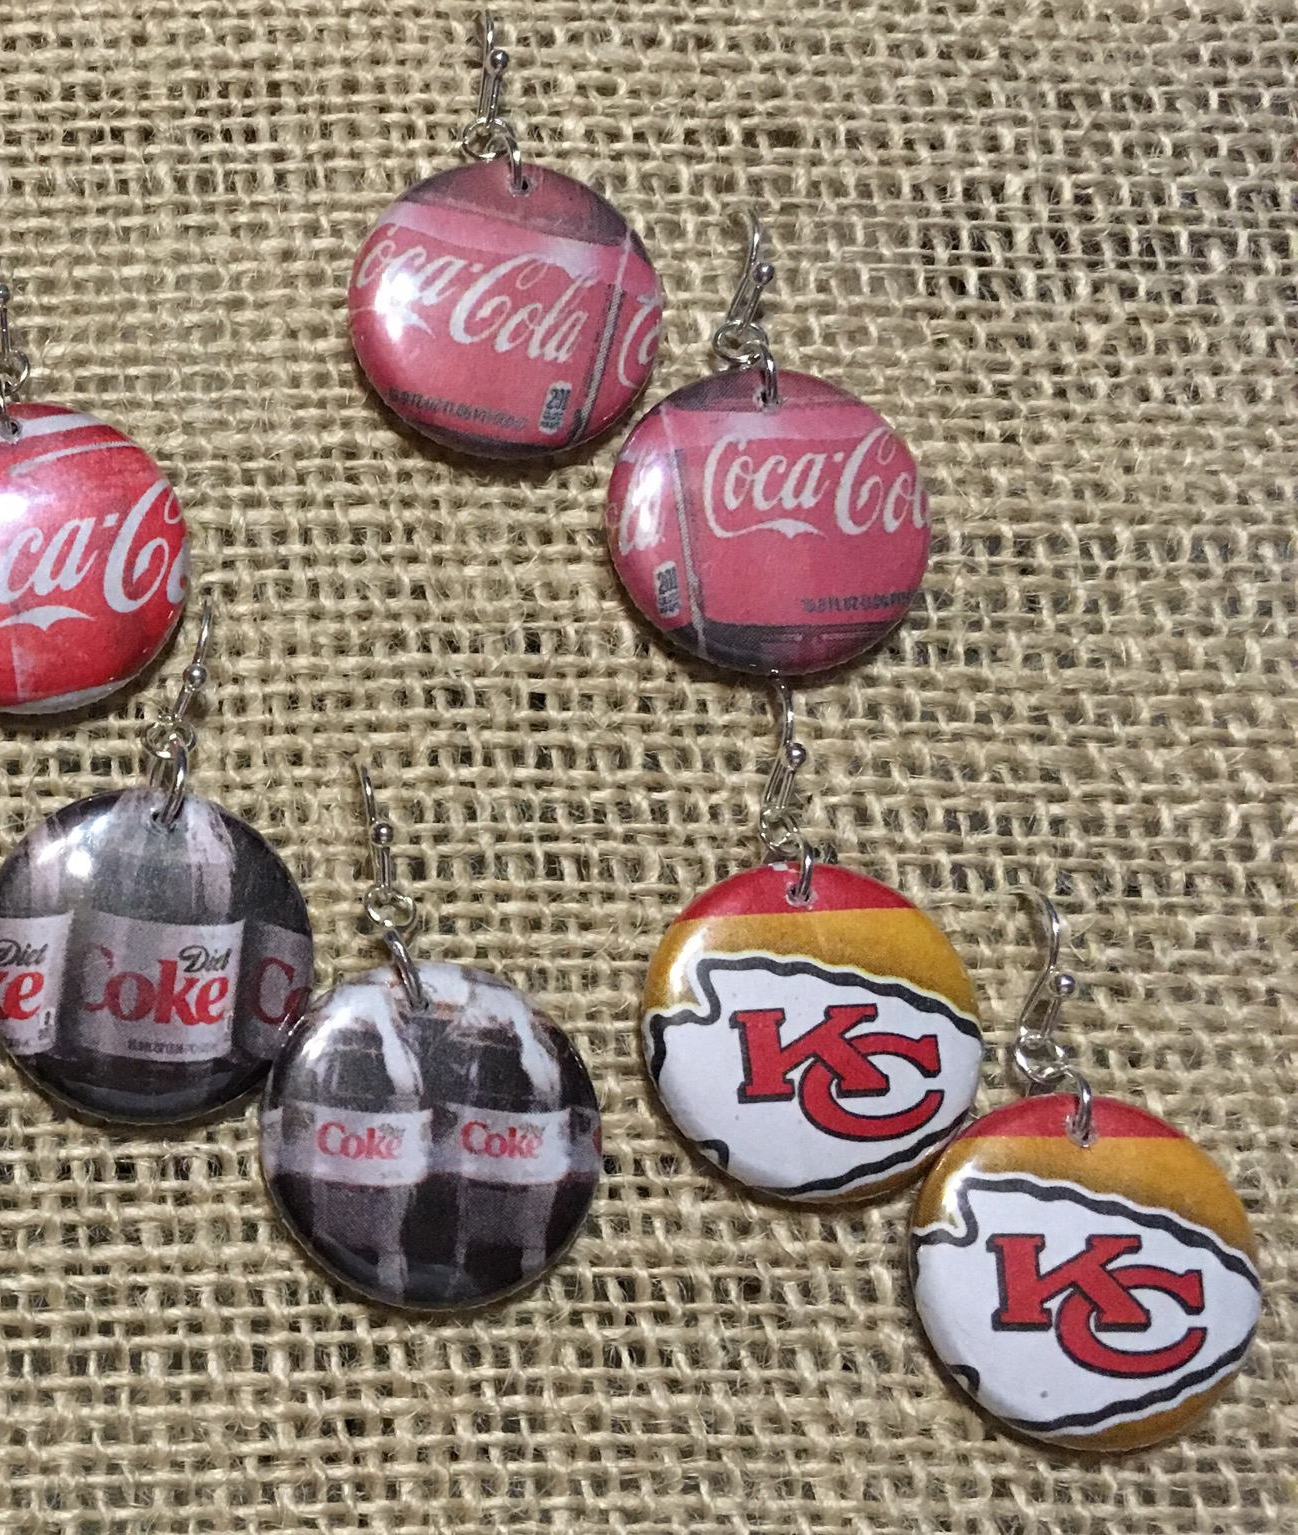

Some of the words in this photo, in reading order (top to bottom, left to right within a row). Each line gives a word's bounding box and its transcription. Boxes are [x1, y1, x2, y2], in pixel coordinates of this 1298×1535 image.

[730, 1003, 945, 1142] KC
[317, 1121, 404, 1160] Coke
[461, 1120, 543, 1159] Coke
[986, 1233, 1208, 1379] KC
